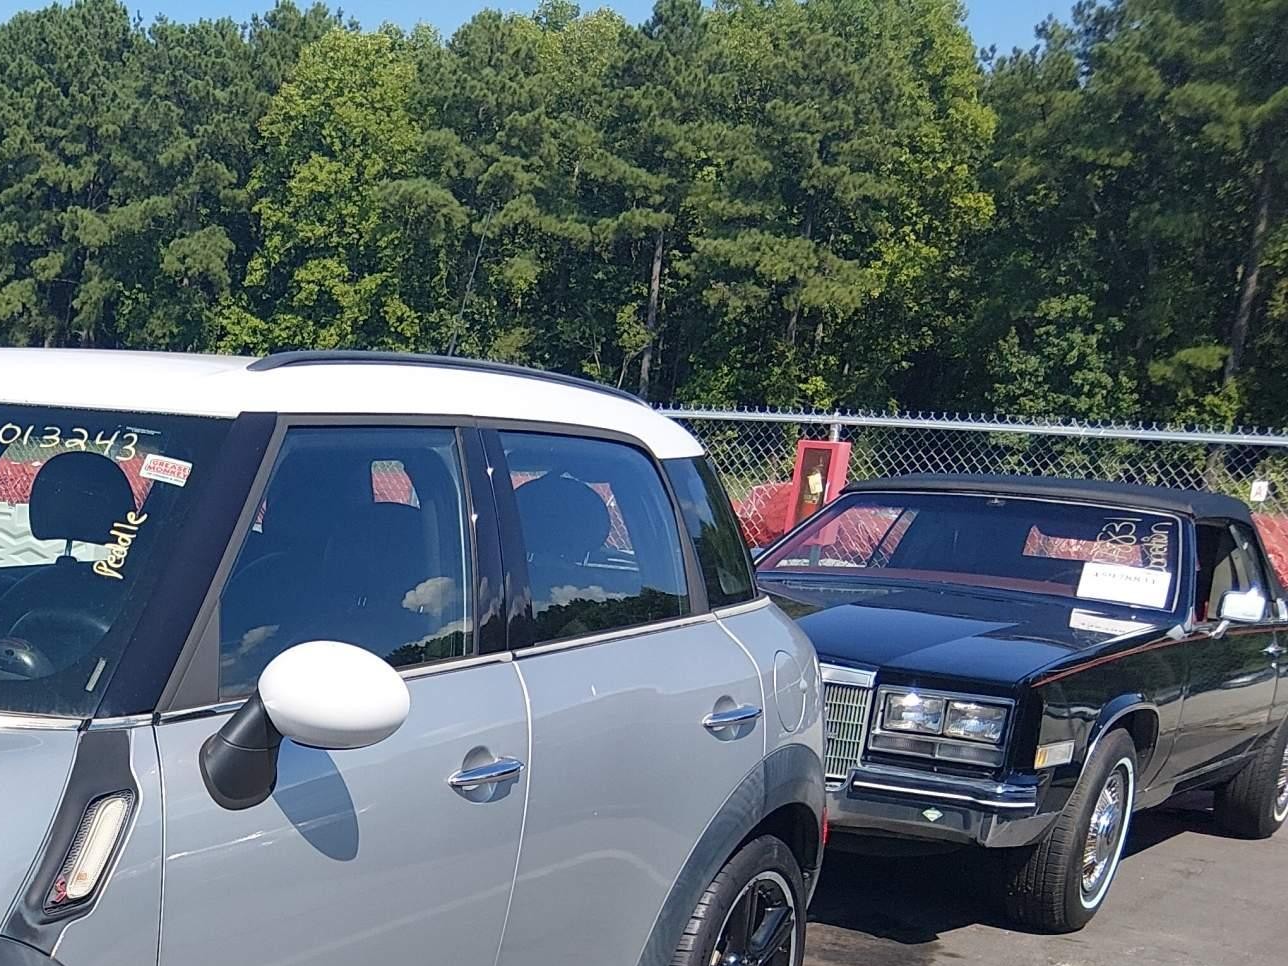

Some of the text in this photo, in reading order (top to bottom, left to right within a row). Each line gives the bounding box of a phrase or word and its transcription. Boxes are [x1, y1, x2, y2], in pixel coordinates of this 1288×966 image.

[146, 464, 189, 479] MONKEY
[152, 460, 189, 473] GREASE
[92, 510, 148, 579] Peddle
